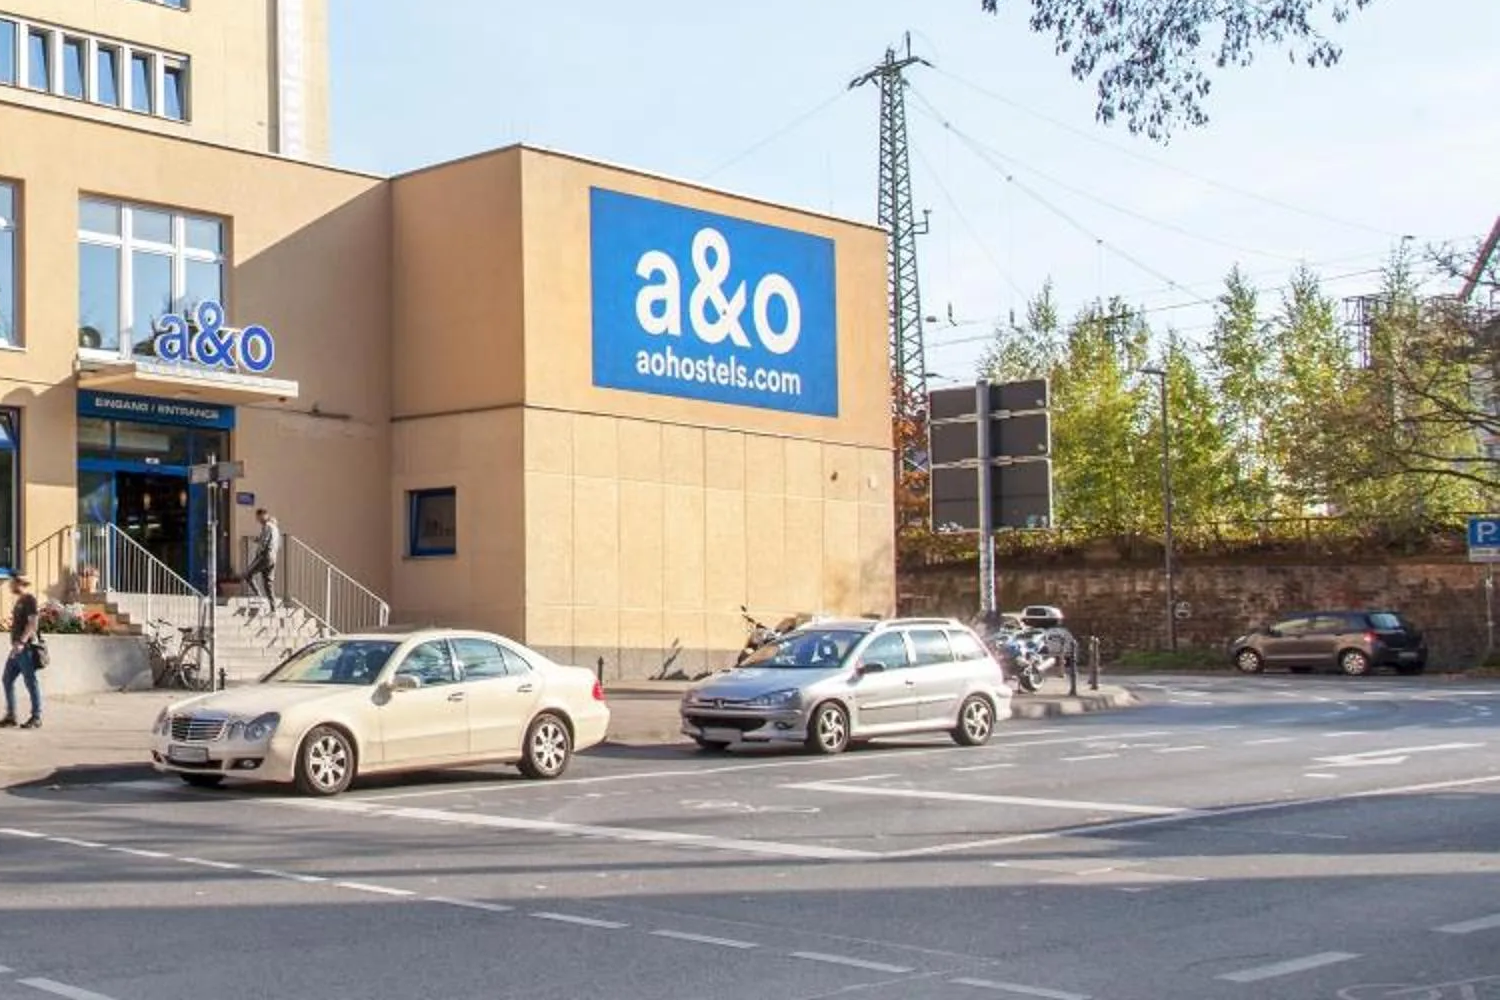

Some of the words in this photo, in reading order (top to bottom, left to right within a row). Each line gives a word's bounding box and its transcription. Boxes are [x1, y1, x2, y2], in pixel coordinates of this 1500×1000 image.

[635, 227, 801, 355] a&o
[154, 299, 274, 373] a&o
[636, 345, 801, 395] aohostels.com
[1477, 521, 1497, 543] P
